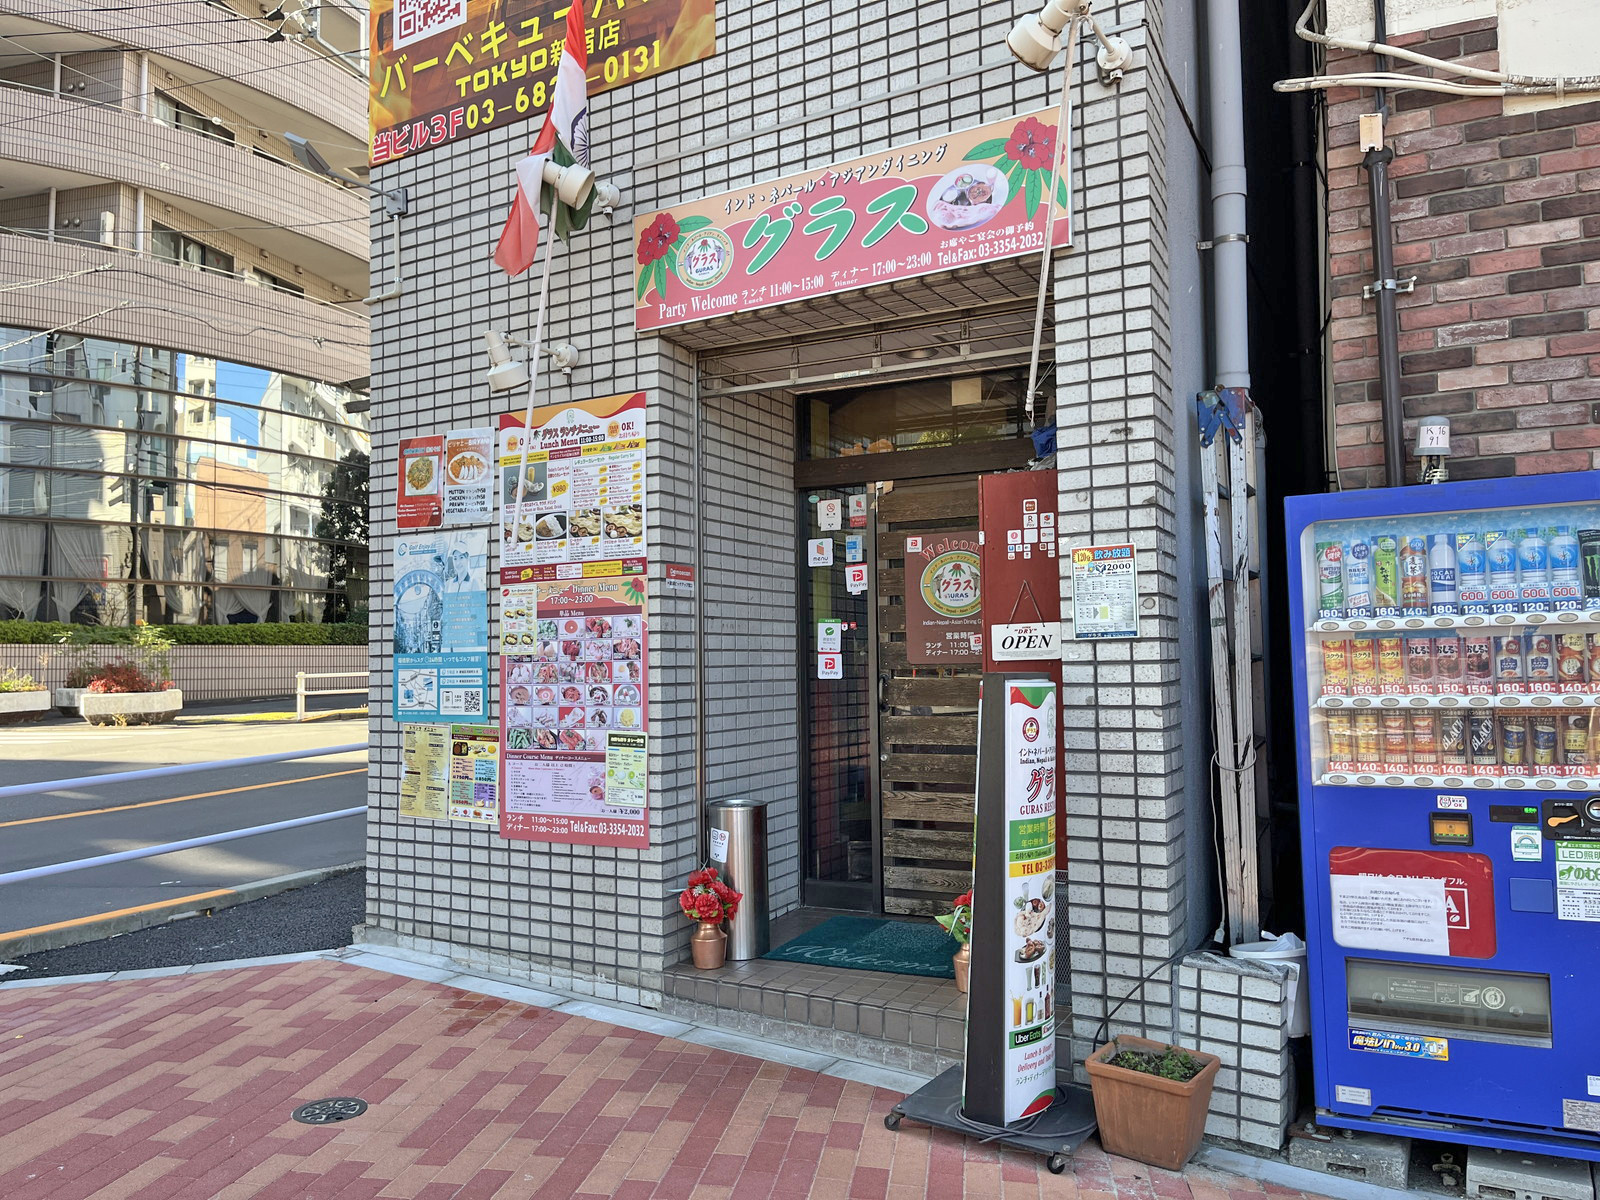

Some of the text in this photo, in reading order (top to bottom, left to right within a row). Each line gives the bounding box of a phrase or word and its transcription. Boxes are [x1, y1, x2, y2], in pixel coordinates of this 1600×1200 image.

[372, 107, 465, 163] 当ビル3F
[742, 184, 930, 276] グラス
[658, 302, 688, 320] Party
[691, 293, 738, 313] Welcome
[741, 285, 767, 299] ランチ
[830, 266, 870, 283] ディナー
[978, 231, 1044, 258] 03-3354-2032
[621, 421, 635, 431] OK!
[1426, 426, 1447, 436] K 16
[540, 440, 560, 449] Lunch
[561, 438, 579, 447] Menu
[1429, 436, 1439, 446] 91
[597, 582, 619, 592] Menu
[942, 578, 974, 593] グラス
[1001, 634, 1053, 650] OPEN
[1020, 803, 1043, 816] GURAS
[506, 814, 524, 822] ランチ
[506, 823, 530, 832] ディナー
[598, 822, 645, 837] 03-3354-2032
[1021, 864, 1034, 875] TEL
[784, 945, 949, 972] Welcome
[1015, 1030, 1041, 1044] Uber Eats
[1017, 1061, 1038, 1073] Delivery
